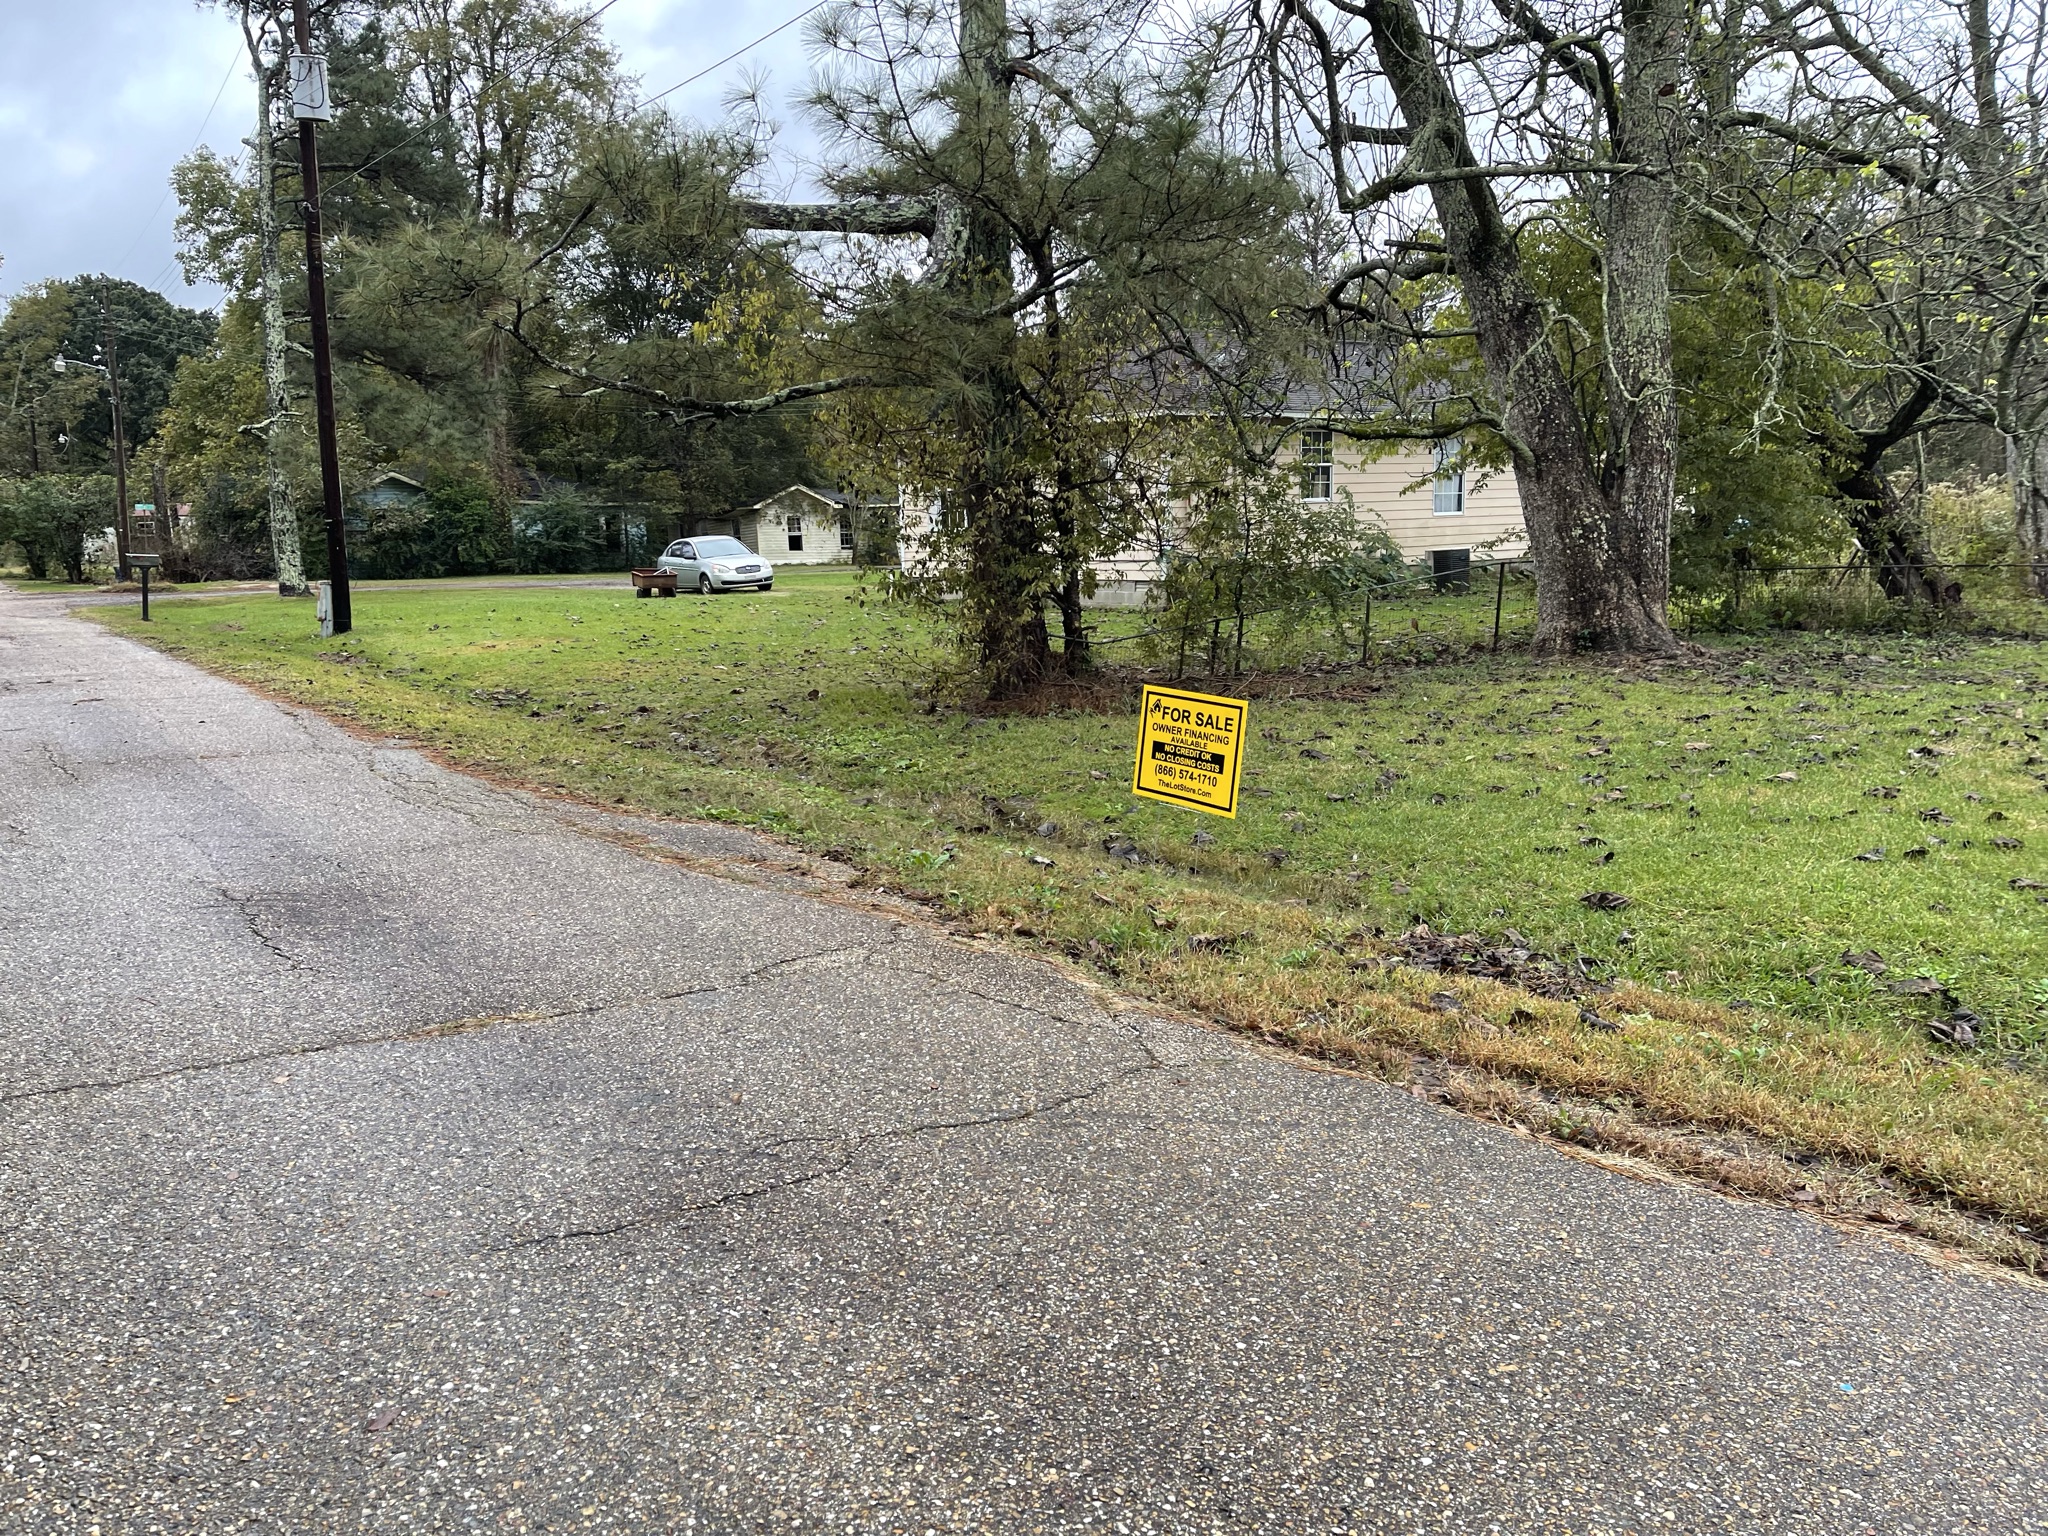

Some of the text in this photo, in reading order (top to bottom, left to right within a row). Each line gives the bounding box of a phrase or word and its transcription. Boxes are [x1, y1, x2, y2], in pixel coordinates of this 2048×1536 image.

[1162, 706, 1234, 732] FOR SALE
[1152, 723, 1229, 745] OWNER FINANCING
[1171, 736, 1207, 749] AVAILABLE
[1155, 752, 1220, 772] NO CLOSING COSTS
[1164, 744, 1212, 761] NO CREDIT OK
[1154, 764, 1217, 787] (866) 574-1710
[1158, 779, 1212, 798] TheLotStore.Com
